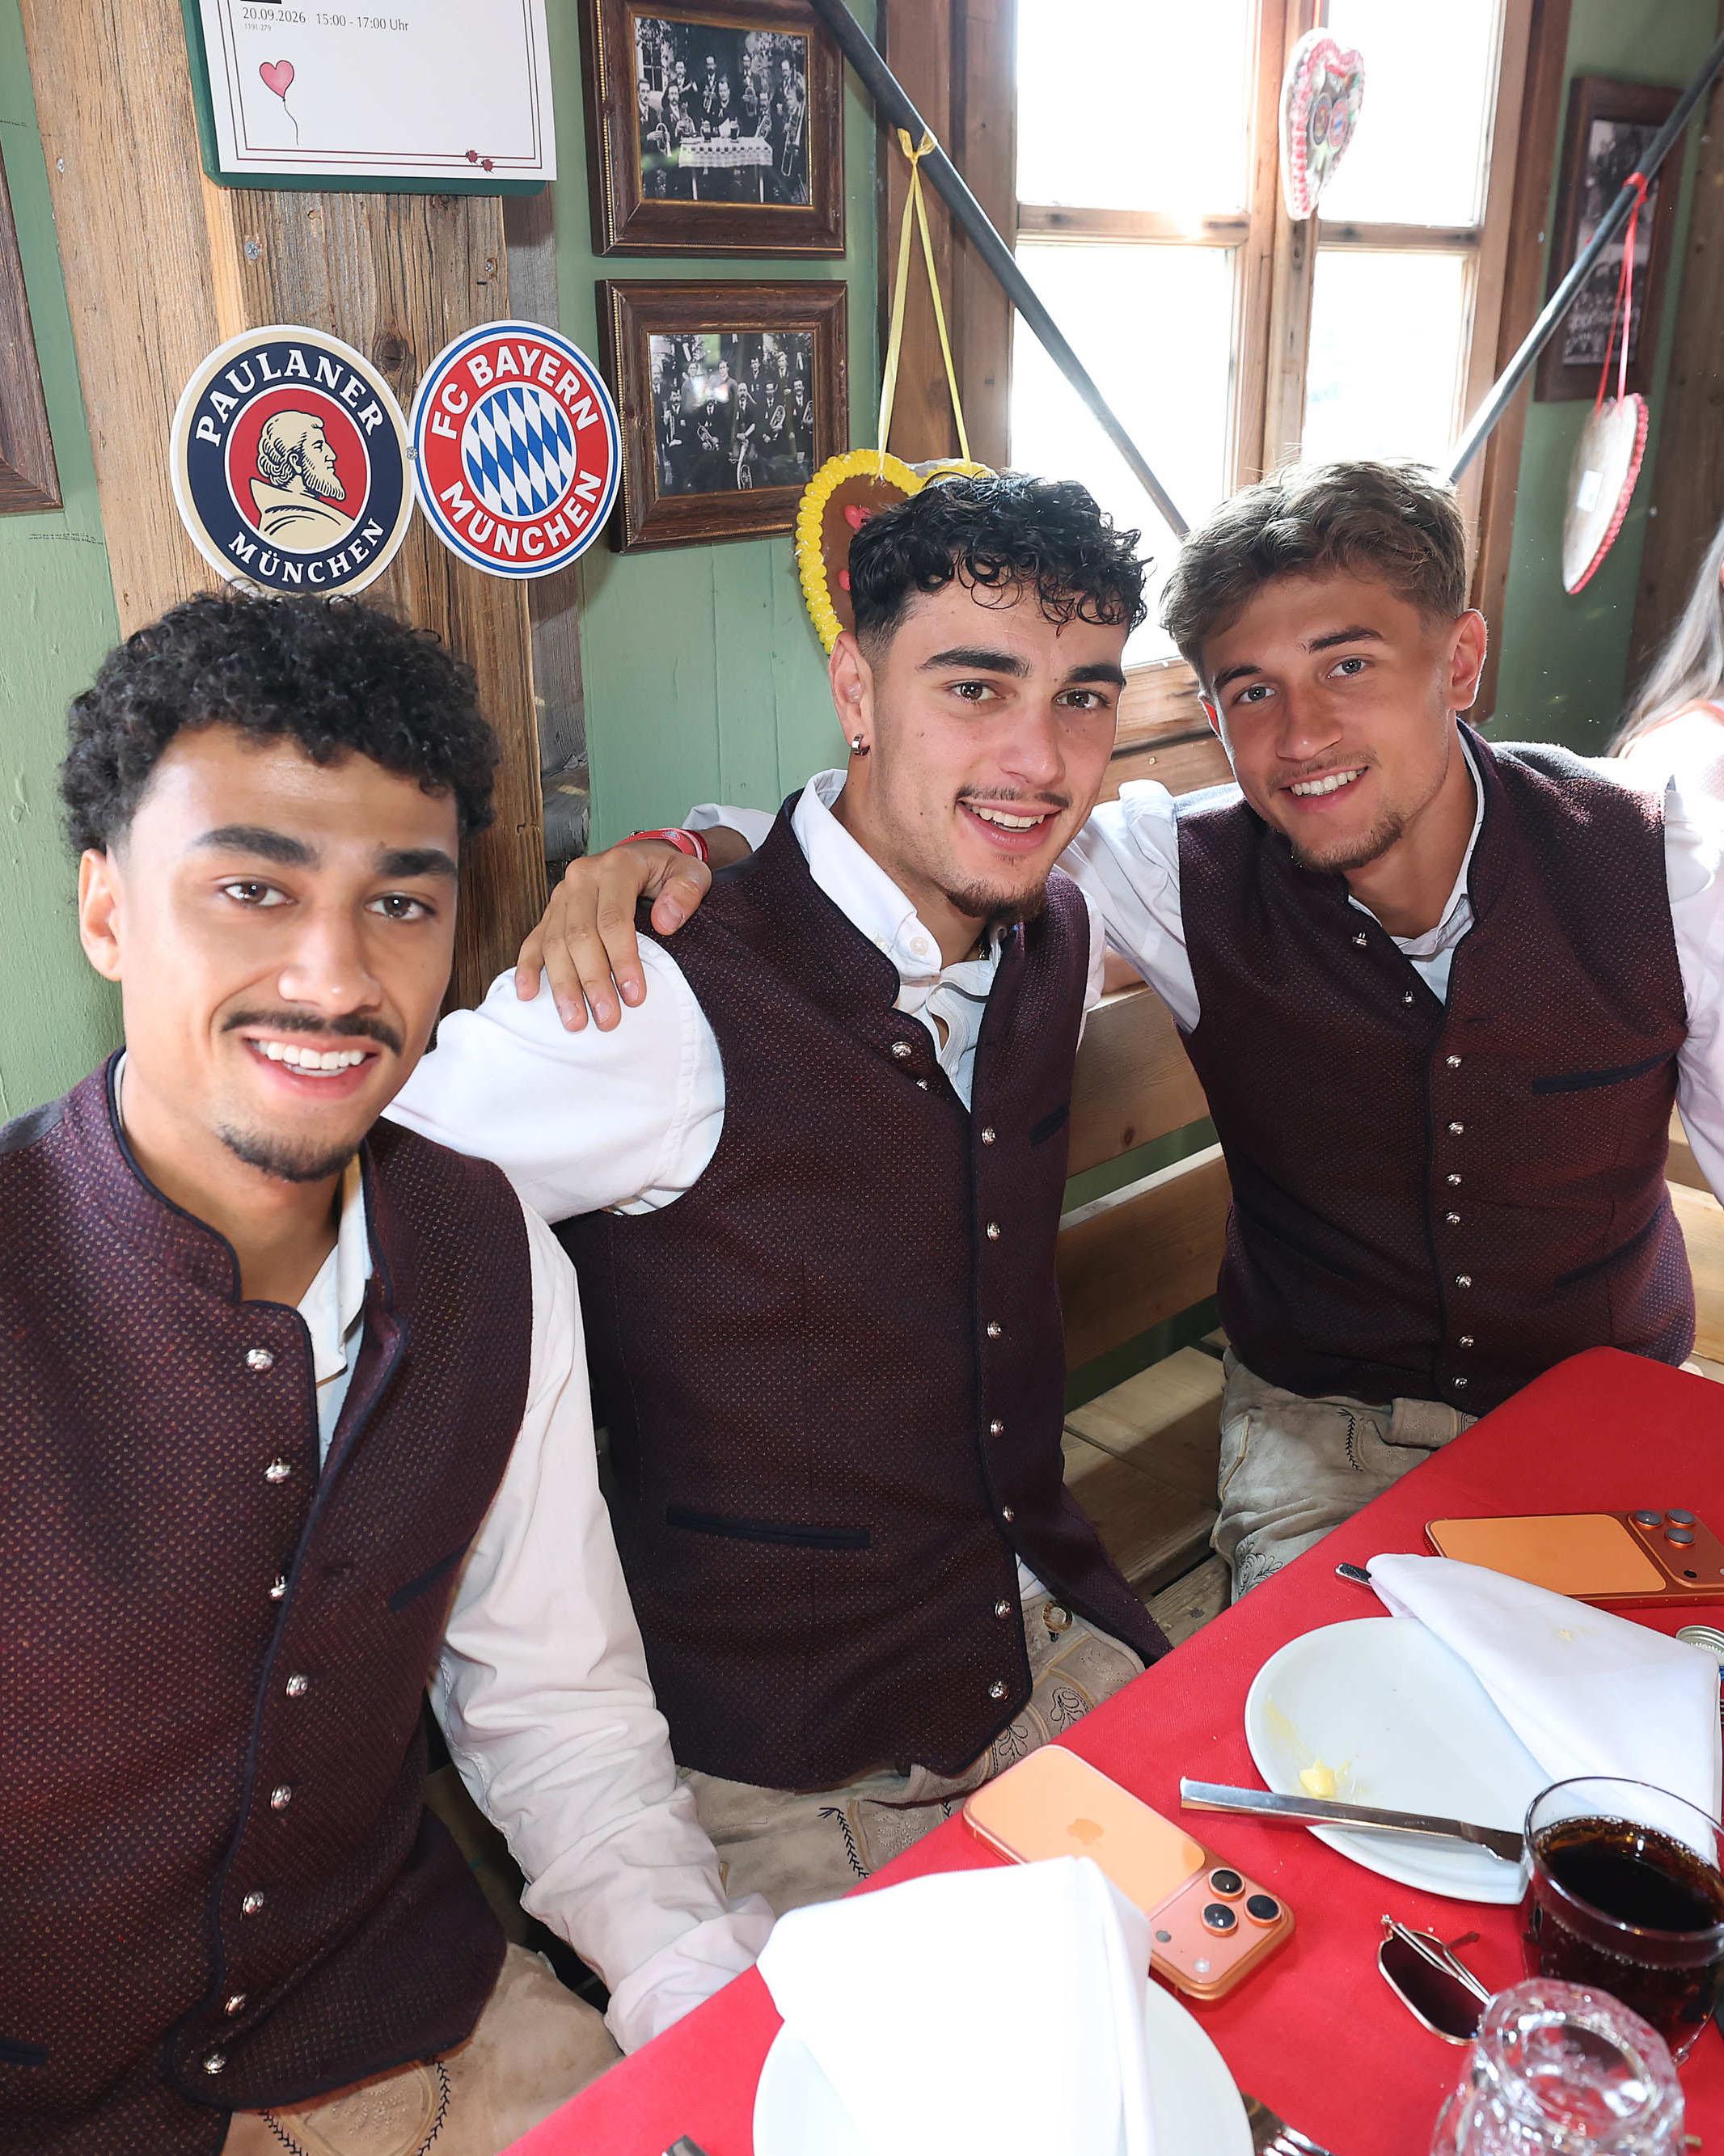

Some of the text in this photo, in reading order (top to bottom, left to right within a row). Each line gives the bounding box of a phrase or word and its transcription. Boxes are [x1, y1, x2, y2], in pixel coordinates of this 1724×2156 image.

[242, 6, 306, 23] 20.09.2026
[316, 12, 347, 27] 15:00
[357, 16, 387, 30] 17:00
[389, 19, 410, 31] Uhr
[196, 349, 383, 446] PAULANER
[431, 345, 598, 440] FC BAYERN
[228, 518, 384, 583] MÜNCHEN
[440, 470, 602, 556] MÜNCHEN
